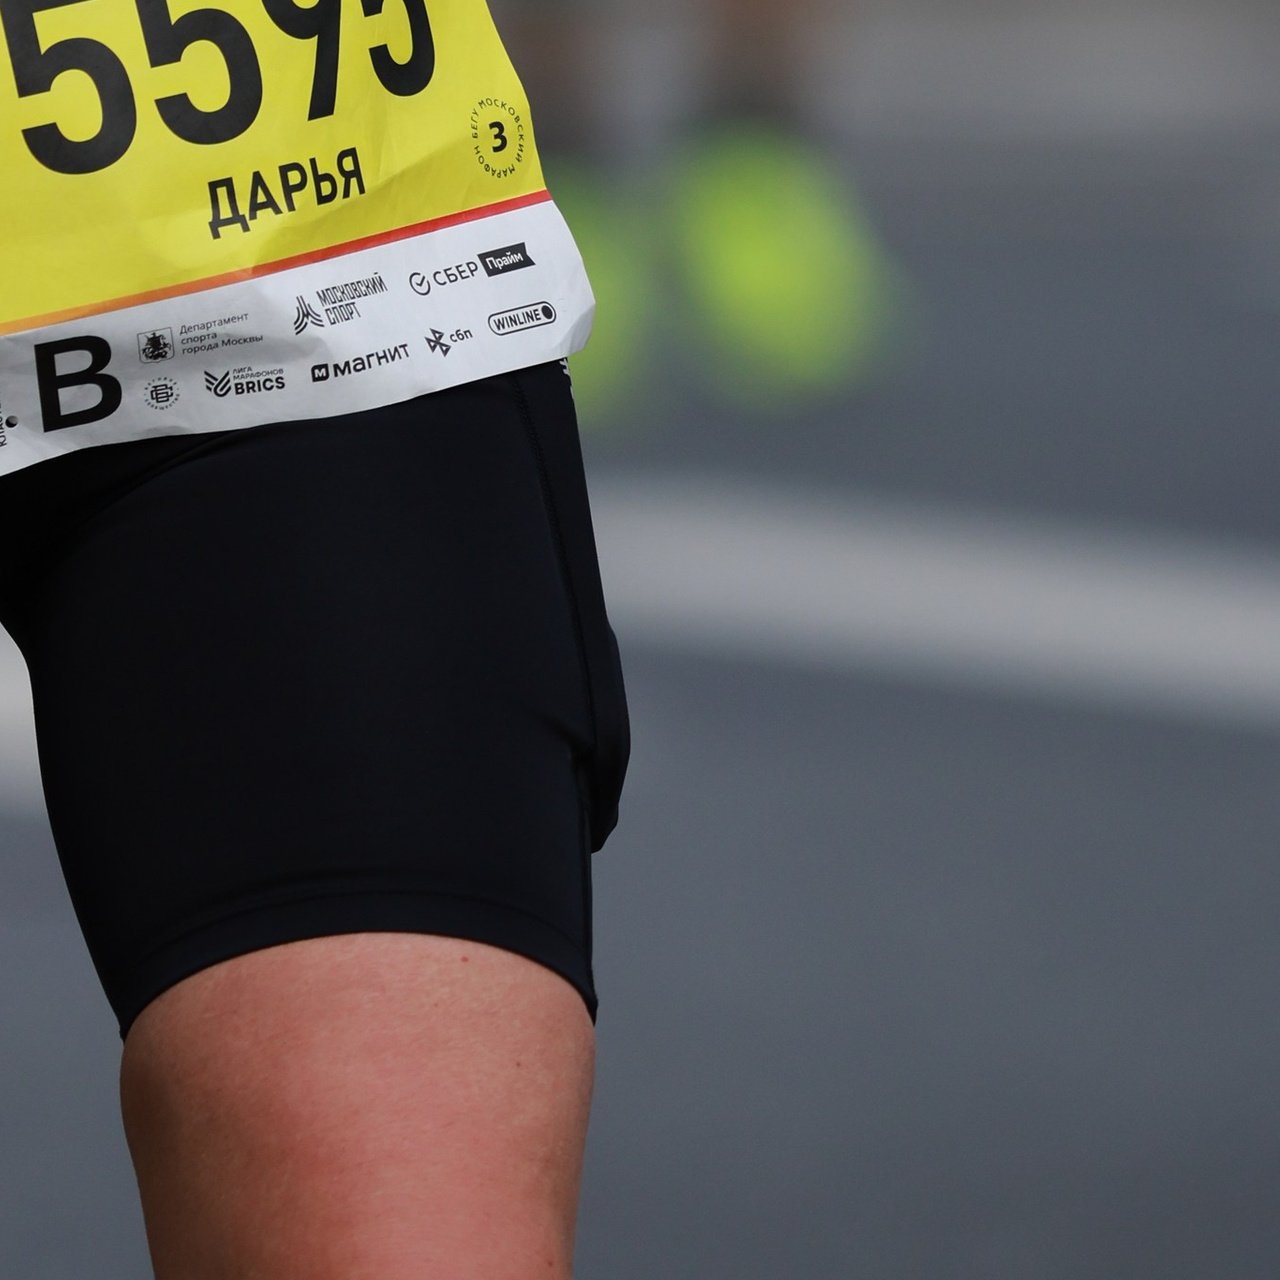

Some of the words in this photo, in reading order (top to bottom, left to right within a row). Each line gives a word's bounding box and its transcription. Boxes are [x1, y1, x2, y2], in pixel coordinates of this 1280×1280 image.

[478, 98, 524, 163] МОСКОВСКИЙ
[488, 121, 508, 153] 3
[474, 145, 515, 178] МАРАФОН
[208, 147, 366, 240] ДАРЬЯ
[433, 261, 478, 286] СБЕР
[485, 251, 524, 270] Прайм
[316, 272, 388, 307] МОСКОВСКИЙ
[179, 313, 249, 336] Департамент
[325, 302, 361, 325] СПОРТ
[493, 308, 542, 331] WINLINE
[181, 333, 217, 345] спорта
[182, 342, 219, 355] города
[221, 335, 264, 347] Москвы
[449, 328, 473, 343] сбп
[233, 366, 252, 374] ЛИГА
[233, 368, 284, 380] МАРАФОНОВ
[34, 335, 122, 433] B
[234, 376, 285, 395] BRICS
